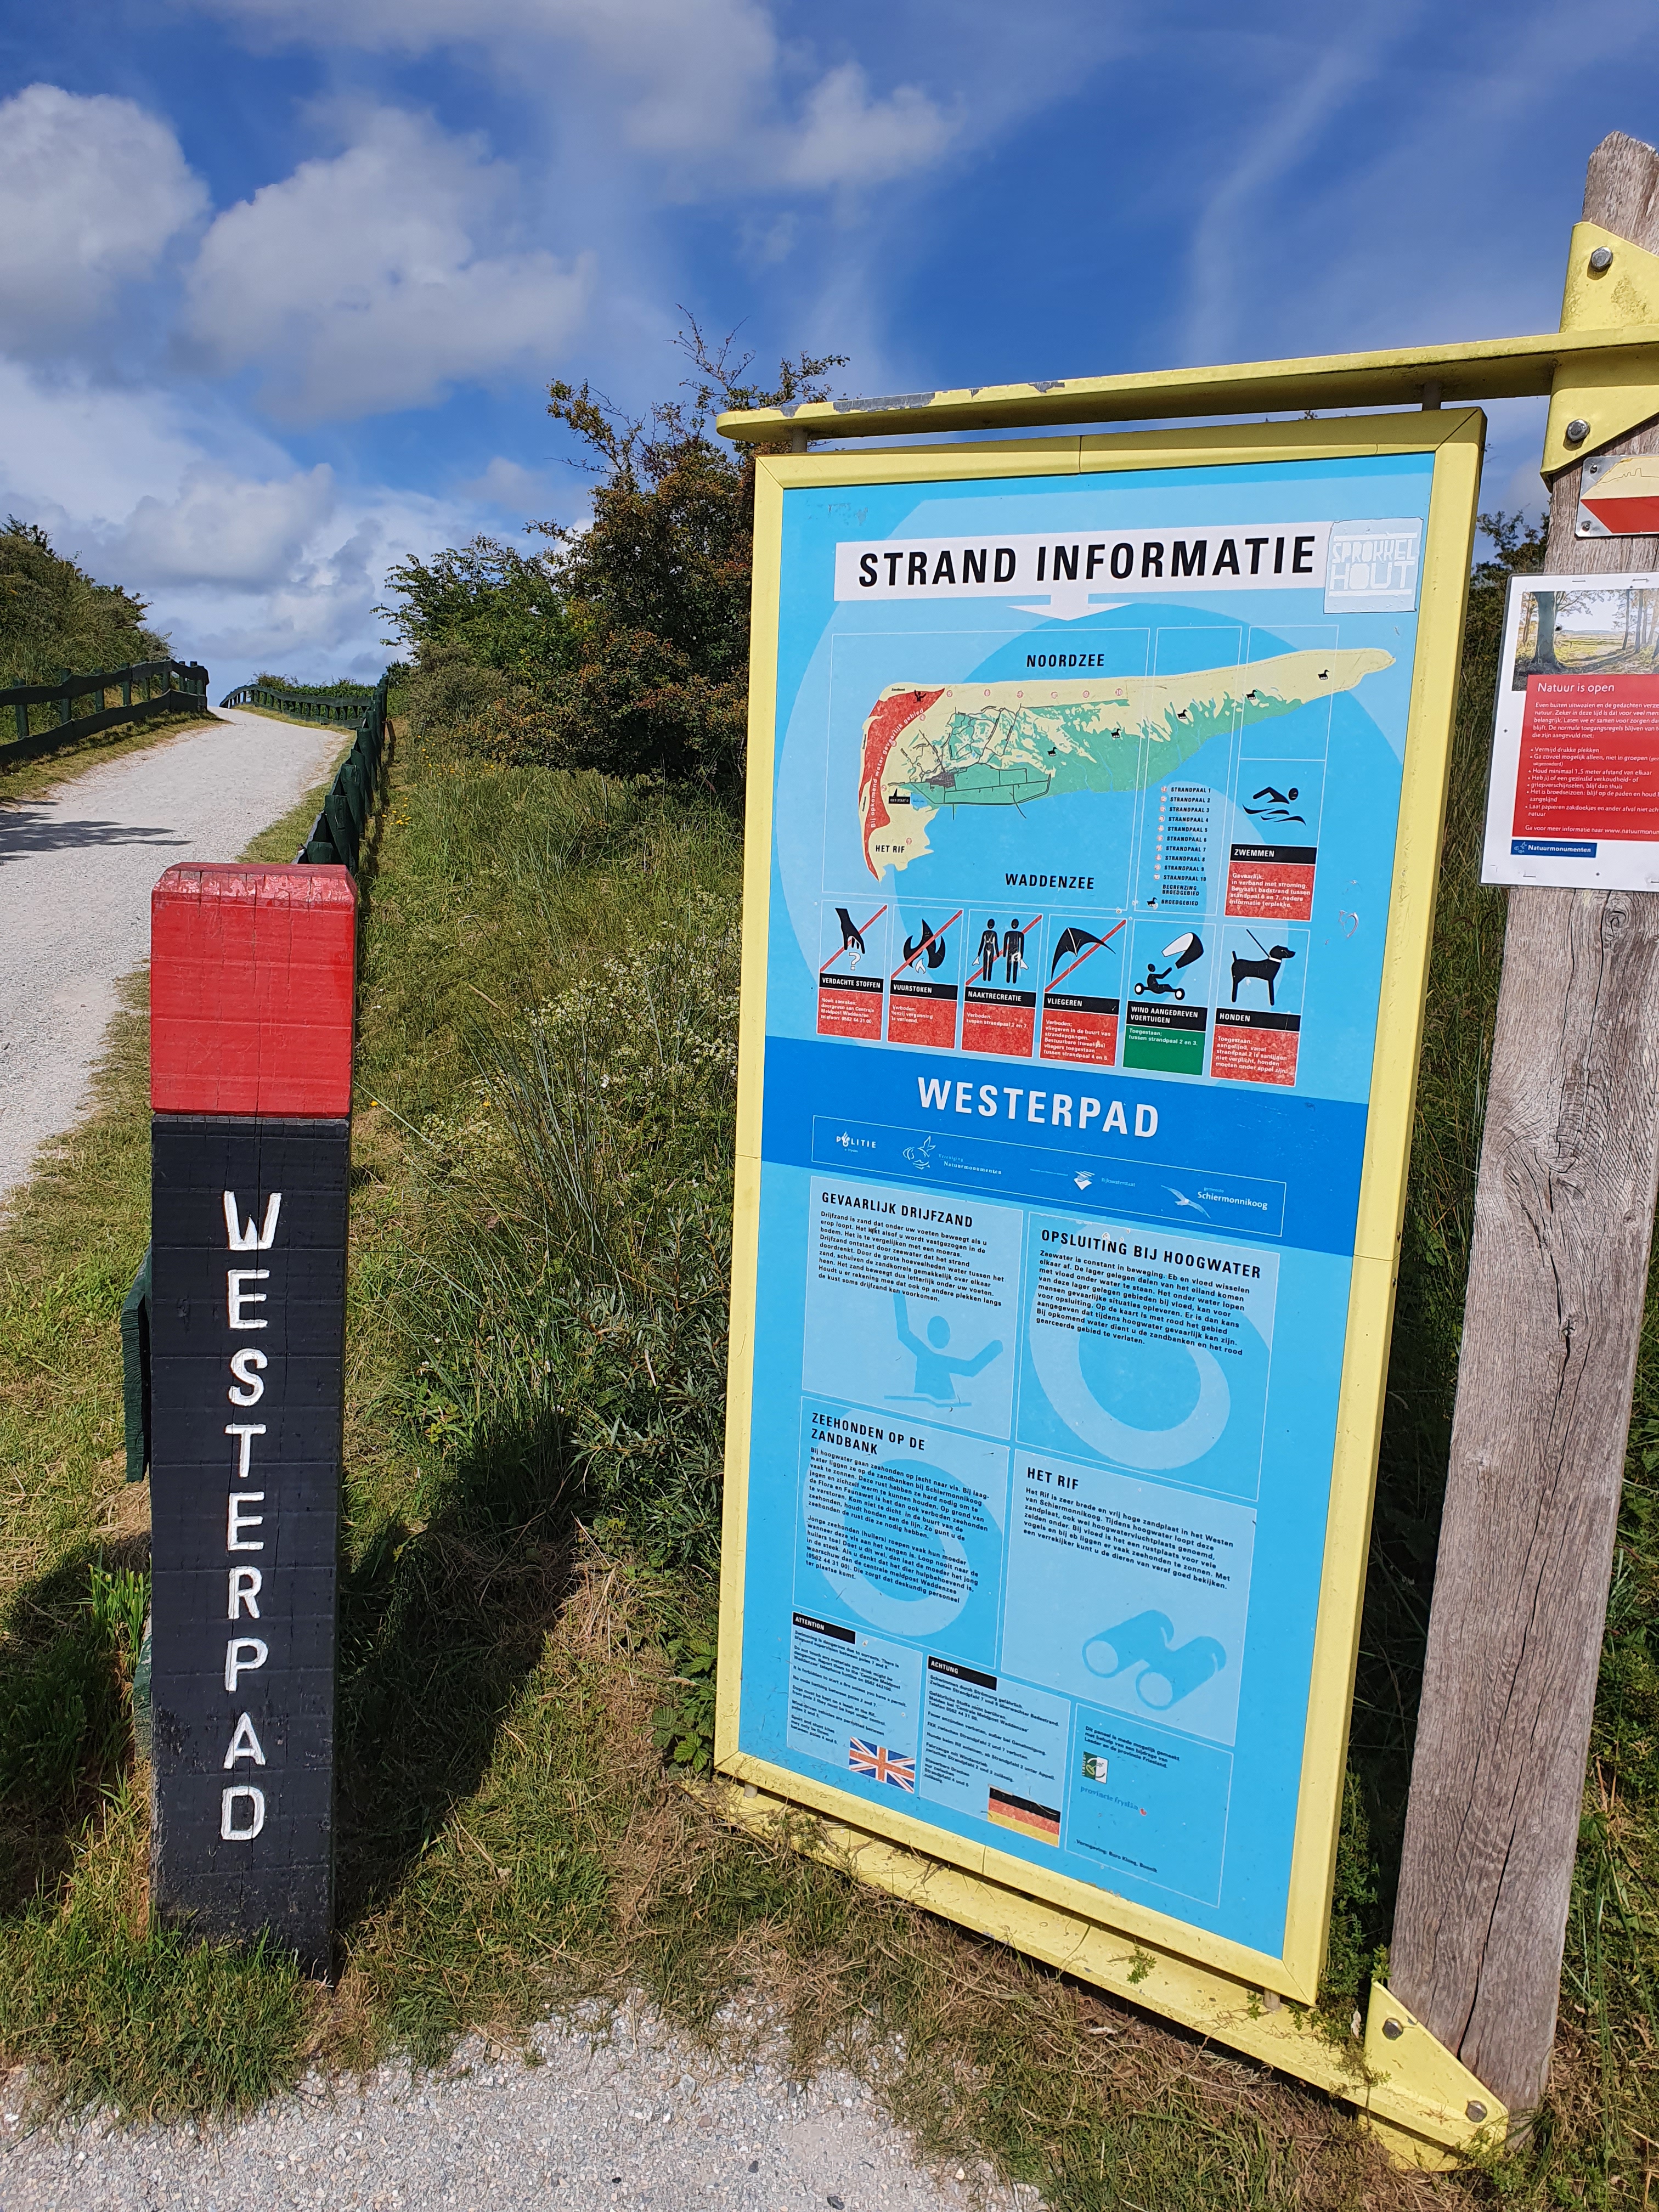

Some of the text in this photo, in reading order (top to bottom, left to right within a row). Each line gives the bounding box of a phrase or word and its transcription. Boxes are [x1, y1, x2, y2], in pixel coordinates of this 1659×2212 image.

[1332, 539, 1415, 563] SPROKKEL
[859, 535, 1314, 587] STRAND INFORMATIE
[1330, 561, 1415, 590] HOUT
[1026, 653, 1104, 667] NOORDZEE
[1538, 682, 1614, 695] Natuur is open
[875, 757, 884, 776] water
[882, 724, 904, 755] gevaarlijk
[904, 708, 924, 725] gebied
[1234, 849, 1274, 857] ZWEMMEN
[1005, 873, 1094, 889] WADDENZEE
[822, 977, 854, 986] VERDACHTE
[893, 984, 932, 993] VUURSTOKEN
[968, 991, 1022, 1001] NAAKTRECREATIE
[1047, 997, 1082, 1007] VLIEGEREN
[1130, 1014, 1170, 1023] VOERTUIGEN
[1150, 1008, 1198, 1018] AANGEDREVEN
[1220, 1013, 1250, 1022] HONDEN
[918, 1076, 1158, 1137] WESTERPAD
[836, 1135, 876, 1148] POLITIE
[938, 1153, 963, 1163] Vereniging
[944, 1160, 1002, 1175] Natuurmonumenten
[1197, 1191, 1268, 1210] Schiermonnikoog
[822, 1192, 972, 1227] GEVAARLIJK DRIJFZAND
[821, 1211, 848, 1221] Drijfzand
[917, 1229, 939, 1237] voeten
[941, 1232, 969, 1243] beweegt
[1042, 1229, 1260, 1279] OPSLUITING BIJ HOOGWATER
[1040, 1250, 1073, 1261] Zeewater
[1084, 1259, 1115, 1269] constant
[1126, 1266, 1165, 1279] beweging.
[1192, 1278, 1213, 1287] vloed
[1215, 1283, 1250, 1294] wisselen
[812, 1412, 924, 1451] ZEEHONDEN OP DE
[811, 1428, 877, 1455] ZANDBANK
[820, 1449, 853, 1463] hoogwater
[870, 1464, 904, 1476] zeehonden
[915, 1474, 931, 1484] jacht
[962, 1487, 971, 1496] Bij
[973, 1489, 989, 1500] laag-
[1027, 1466, 1079, 1489] HET RIF
[222, 1190, 283, 1841] WESTERPAD
[1026, 1487, 1037, 1496] Het
[1076, 1500, 1096, 1511] brede
[1109, 1510, 1120, 1519] vrij
[1122, 1513, 1141, 1522] hoge
[1143, 1519, 1179, 1533] zandplaat
[1190, 1531, 1203, 1539] het
[1205, 1534, 1233, 1547] Westen
[795, 1616, 824, 1630] ATTENTION
[930, 1660, 958, 1674] ACHTUNG
